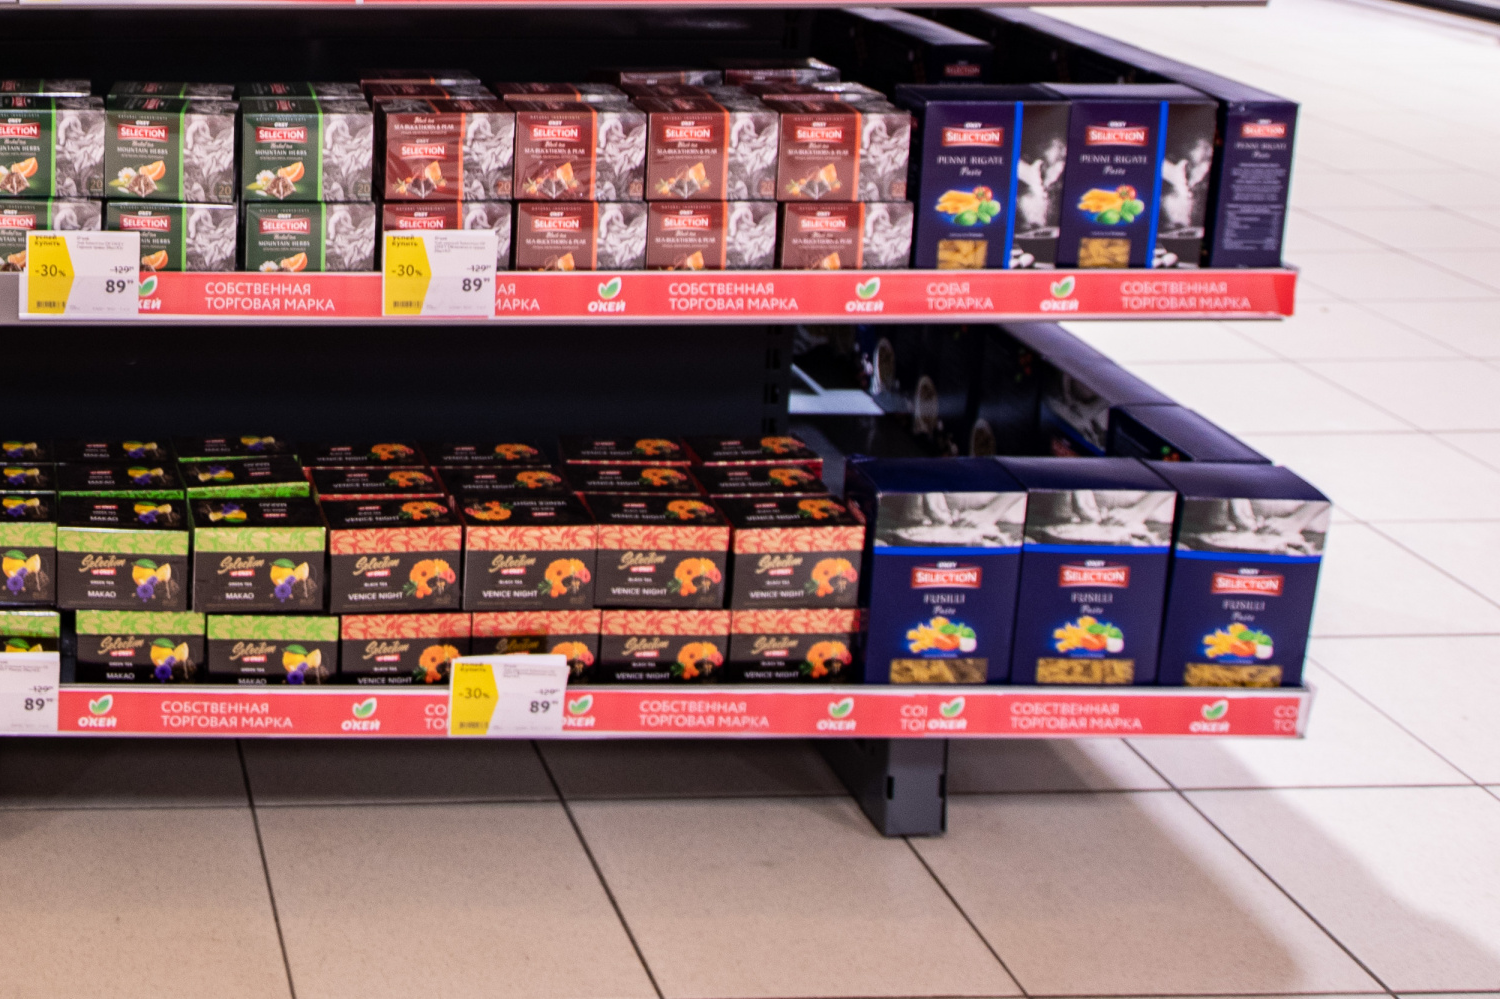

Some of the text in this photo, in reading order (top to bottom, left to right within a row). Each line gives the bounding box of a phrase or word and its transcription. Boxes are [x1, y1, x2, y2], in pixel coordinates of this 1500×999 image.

[259, 129, 303, 141] SELECTION
[533, 127, 578, 139] SELECTION
[946, 131, 1000, 143] SELECTION
[205, 282, 311, 296] СОБСТВЕННАЯ
[205, 297, 335, 311] ТОРГОВАЯ МАРКА
[1063, 570, 1125, 583] SELECTION
[348, 592, 403, 601] VENICE NIGHT
[611, 588, 667, 596] VENICE NIGHT
[639, 701, 747, 714] СОБСТВЕННАЯ
[639, 715, 769, 728] ТОРГОВАЯ МАРКА
